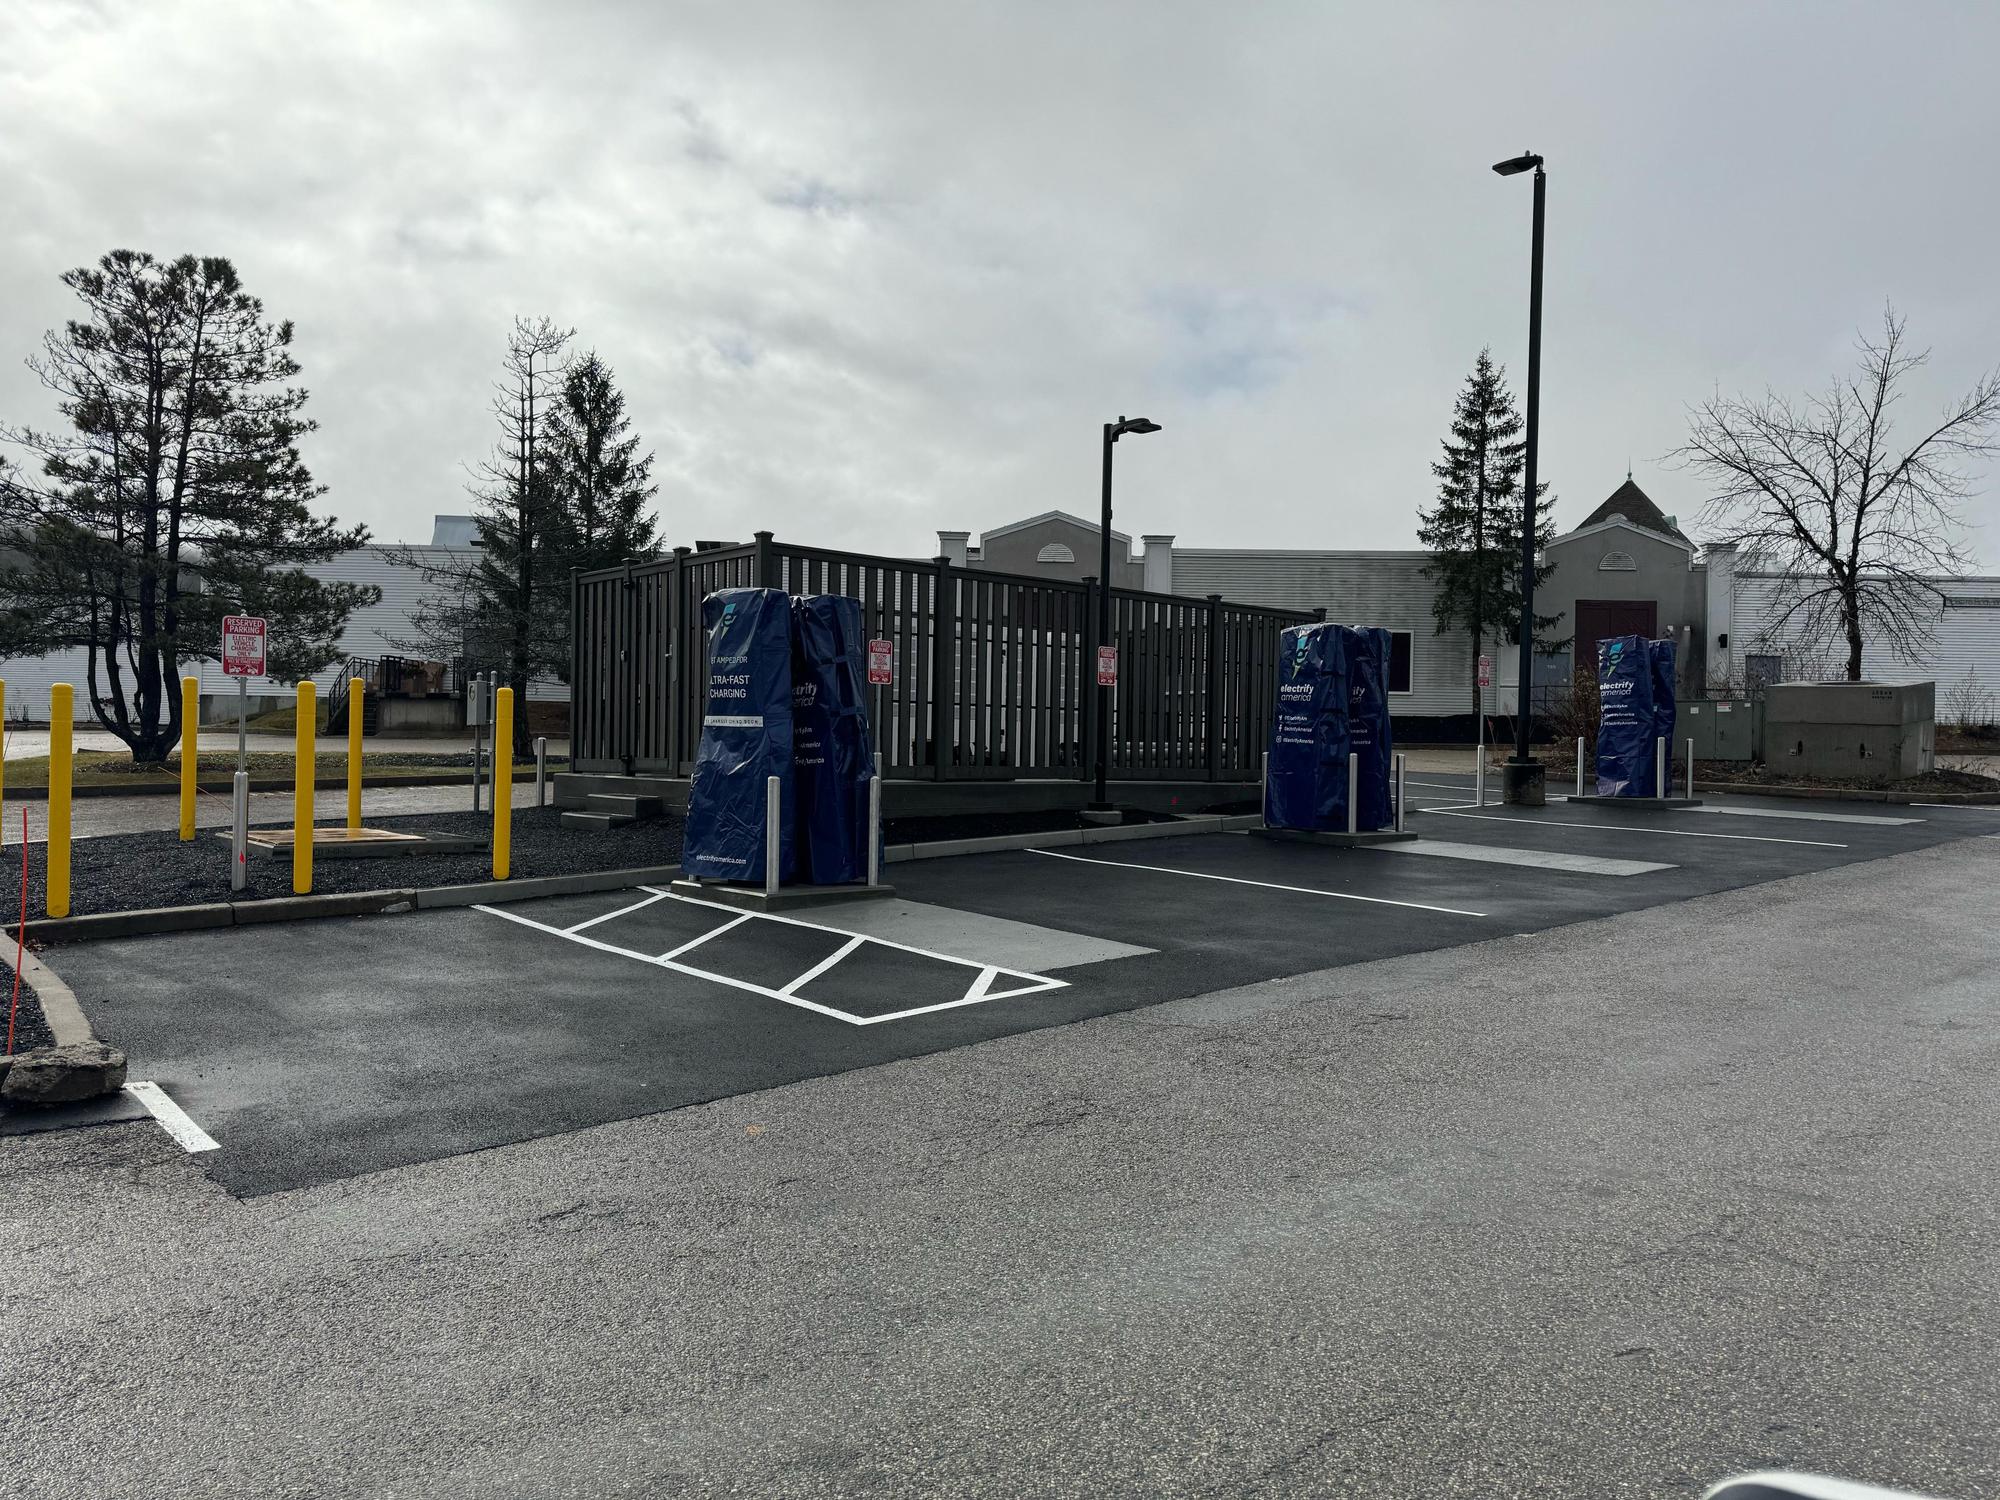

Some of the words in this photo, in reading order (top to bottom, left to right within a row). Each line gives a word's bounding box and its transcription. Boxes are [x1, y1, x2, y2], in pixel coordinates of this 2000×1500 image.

[228, 618, 262, 626] RESERVED
[716, 656, 736, 664] AMPED
[736, 656, 748, 664] FOR
[709, 675, 750, 685] LTRA-FAST
[1280, 684, 1314, 695] electrify
[1599, 681, 1634, 690] electrify
[709, 688, 747, 699] CHARGING
[1600, 689, 1632, 697] america
[1281, 694, 1311, 702] america
[696, 854, 746, 864] electrifyamerica.com
